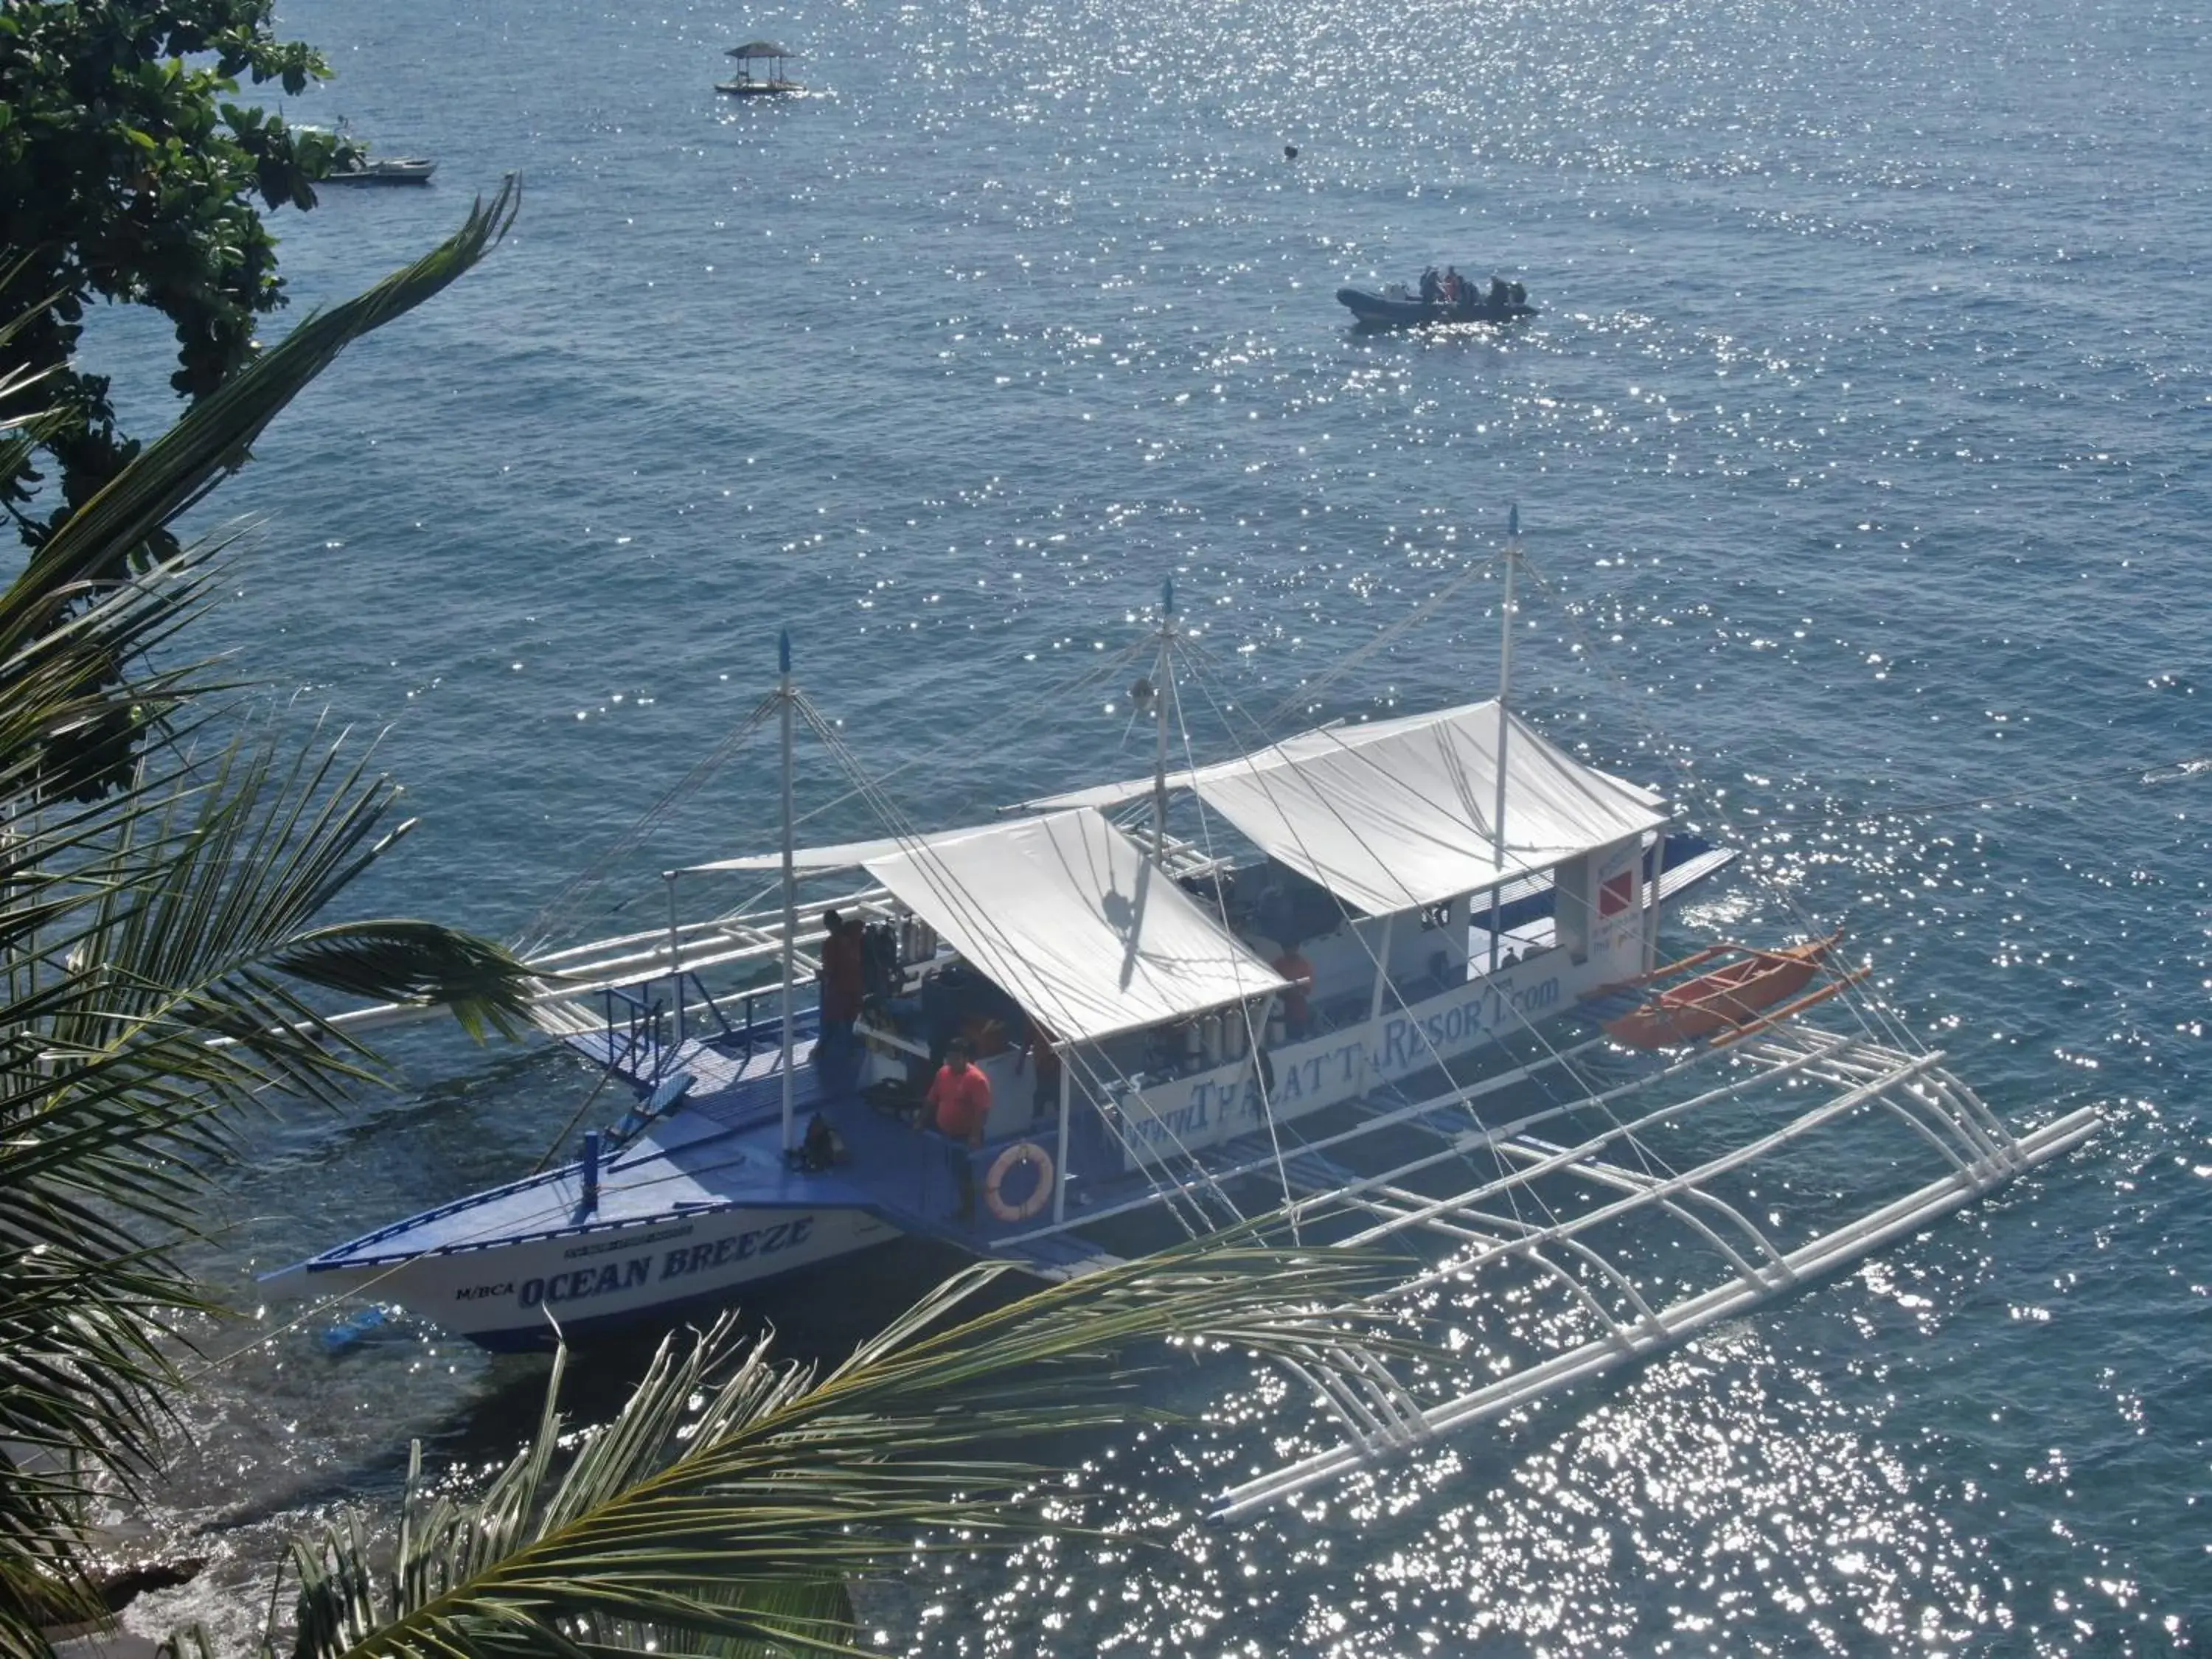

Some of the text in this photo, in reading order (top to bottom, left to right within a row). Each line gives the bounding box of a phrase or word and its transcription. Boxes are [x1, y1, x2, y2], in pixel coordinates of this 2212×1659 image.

[455, 1281, 515, 1301] M/BCA
[518, 1256, 651, 1310] OCEAN
[658, 1217, 814, 1283] BREEZE
